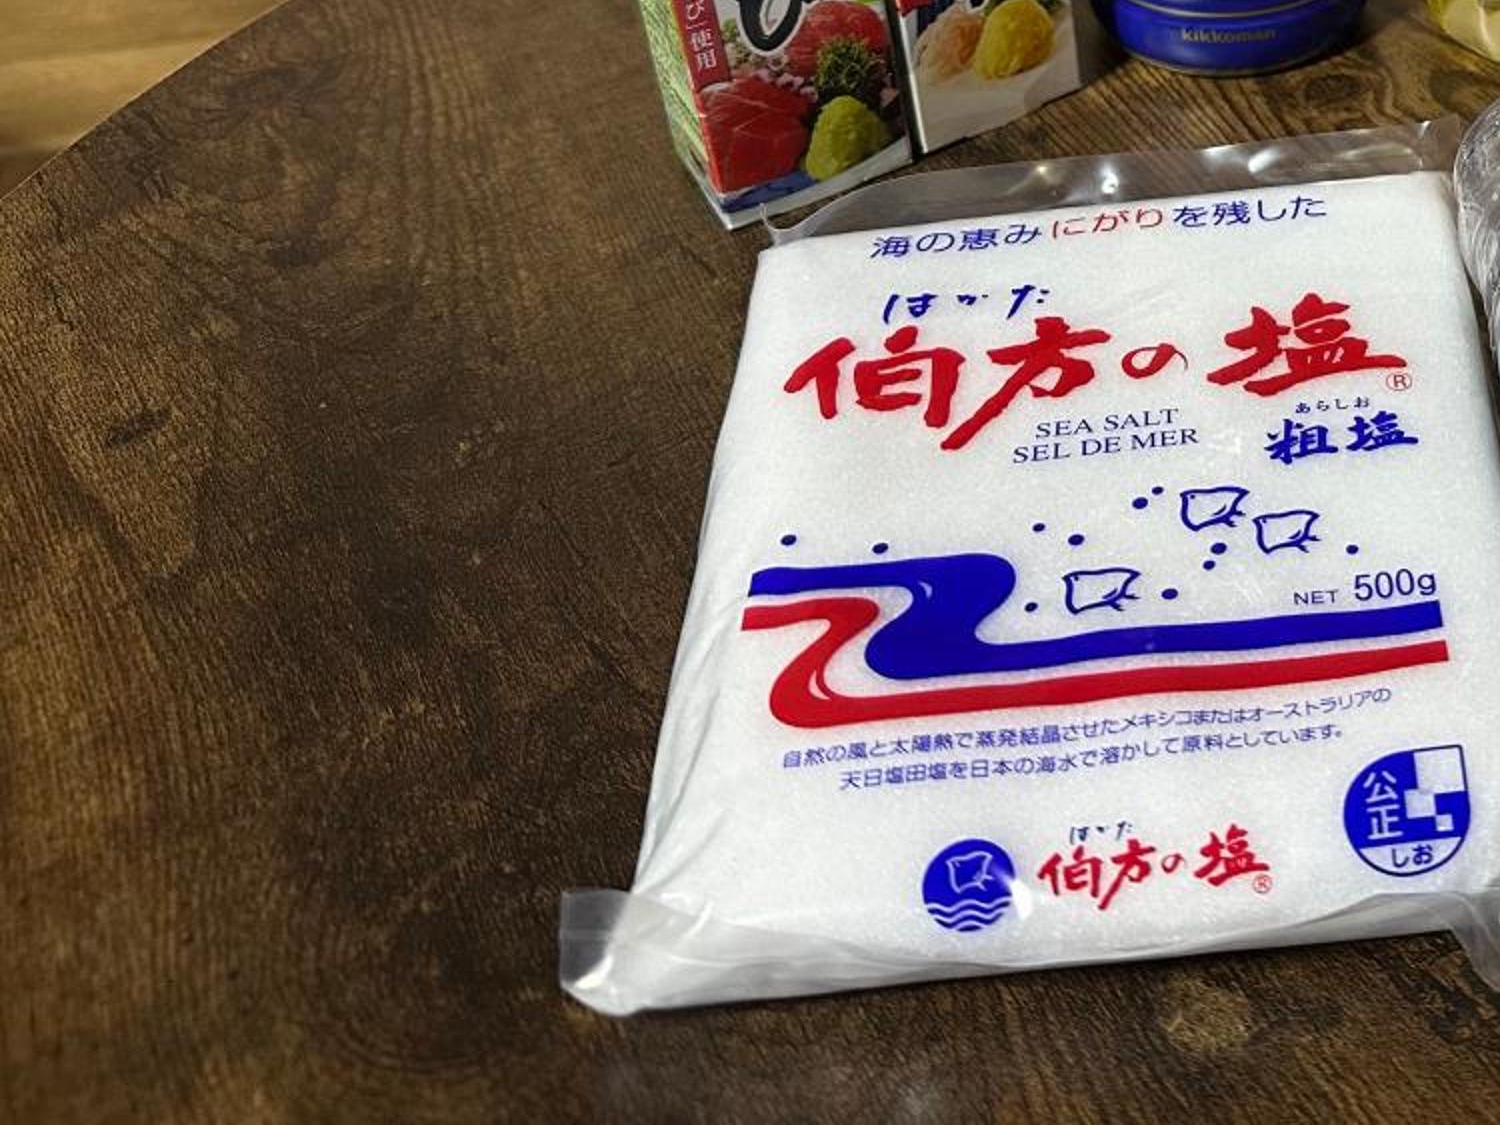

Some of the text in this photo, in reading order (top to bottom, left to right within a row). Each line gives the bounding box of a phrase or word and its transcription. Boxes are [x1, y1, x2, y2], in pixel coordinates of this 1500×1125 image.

[784, 292, 1408, 452] 伯方の塩
[1035, 407, 1180, 440] SEA SALT
[1294, 397, 1371, 415] あらしお
[1012, 427, 1201, 465] SEL DE MER
[1263, 411, 1420, 465] 粗塩
[1293, 568, 1438, 606] NET 500g
[1363, 770, 1404, 841] 公正
[1038, 823, 1270, 911] 伯方の塩
[1391, 842, 1434, 868] しお
